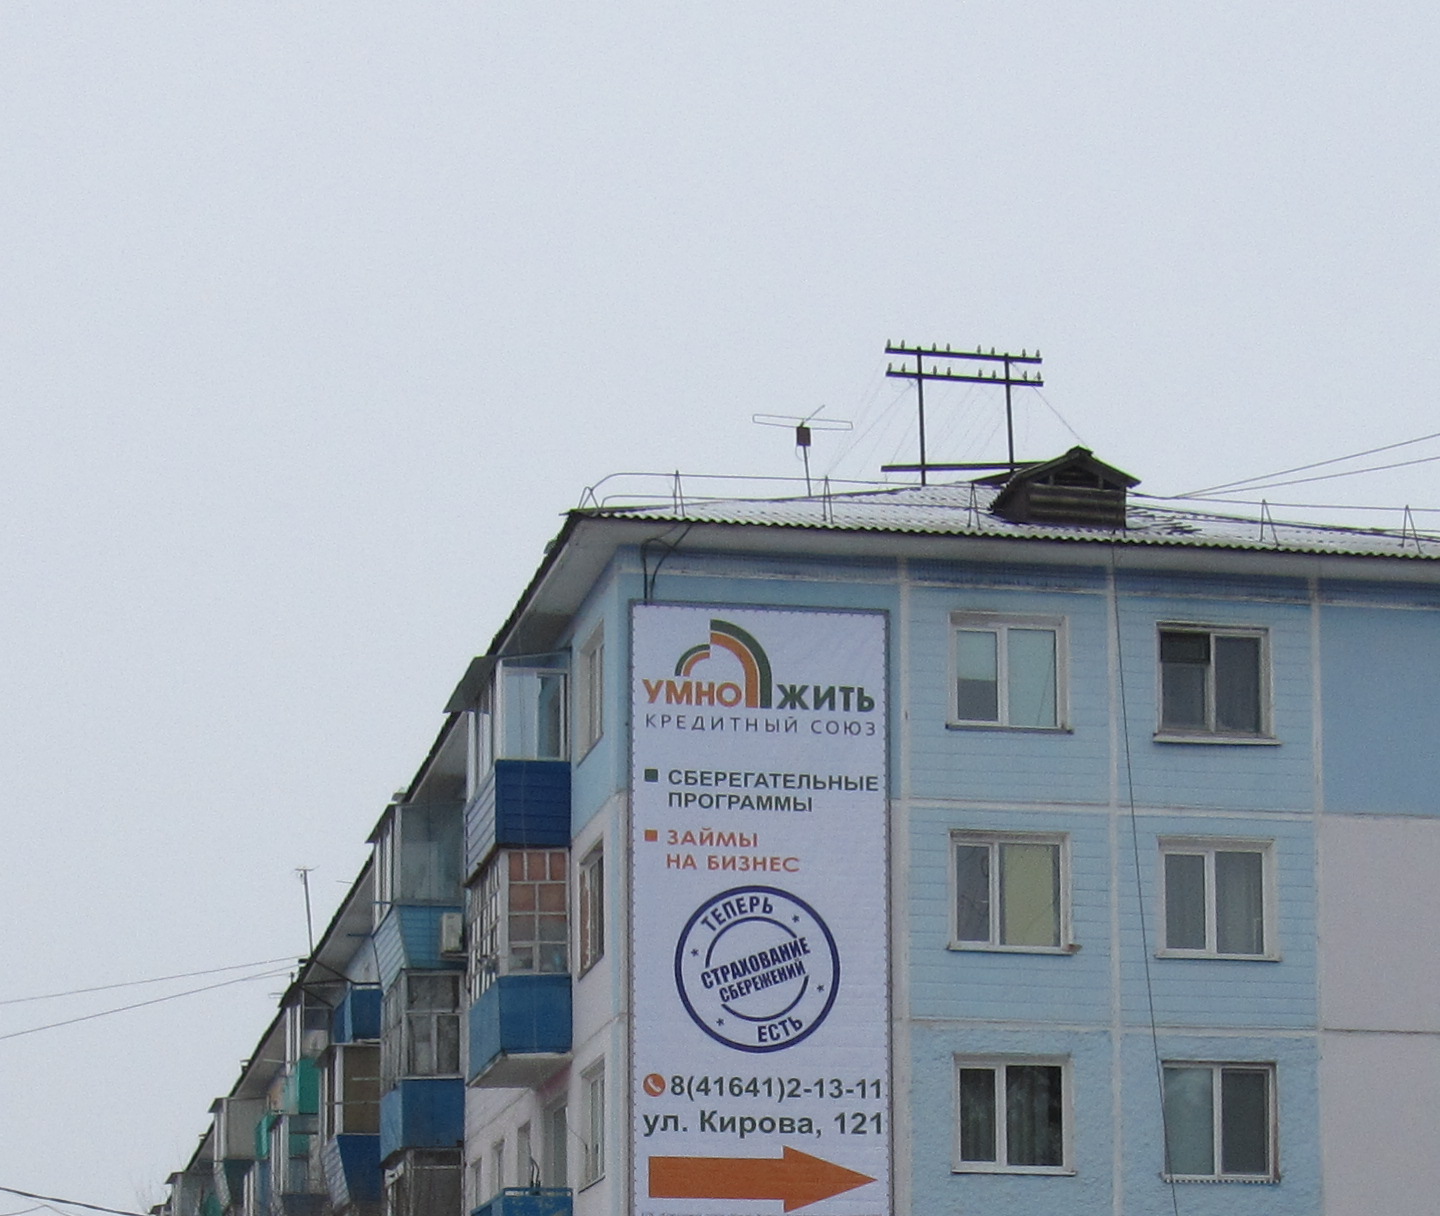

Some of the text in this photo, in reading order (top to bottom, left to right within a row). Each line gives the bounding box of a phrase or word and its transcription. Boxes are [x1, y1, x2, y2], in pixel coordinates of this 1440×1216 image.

[642, 679, 876, 712] УМНО ЖИТЬ
[645, 713, 876, 736] КРЕДИТНЫЙ СОЮЗ
[668, 769, 879, 791] СБЕРЕГАТЕЛЬНЫЕ
[668, 792, 813, 812] ПРОГРАММЫ
[667, 827, 758, 847] ЗАЙМЫ
[667, 854, 800, 872] НА БИЗНЕС
[700, 896, 773, 932] ТЕПЕРЬ
[700, 937, 811, 990] СТРАХОВАНИЕ
[718, 957, 806, 1004] СБЕРЕЖЕНИЙ
[757, 1016, 803, 1043] ЕСТЬ
[670, 1075, 882, 1102] 8(41641)2-13-11
[643, 1110, 883, 1138] ул. Кирова, 121
